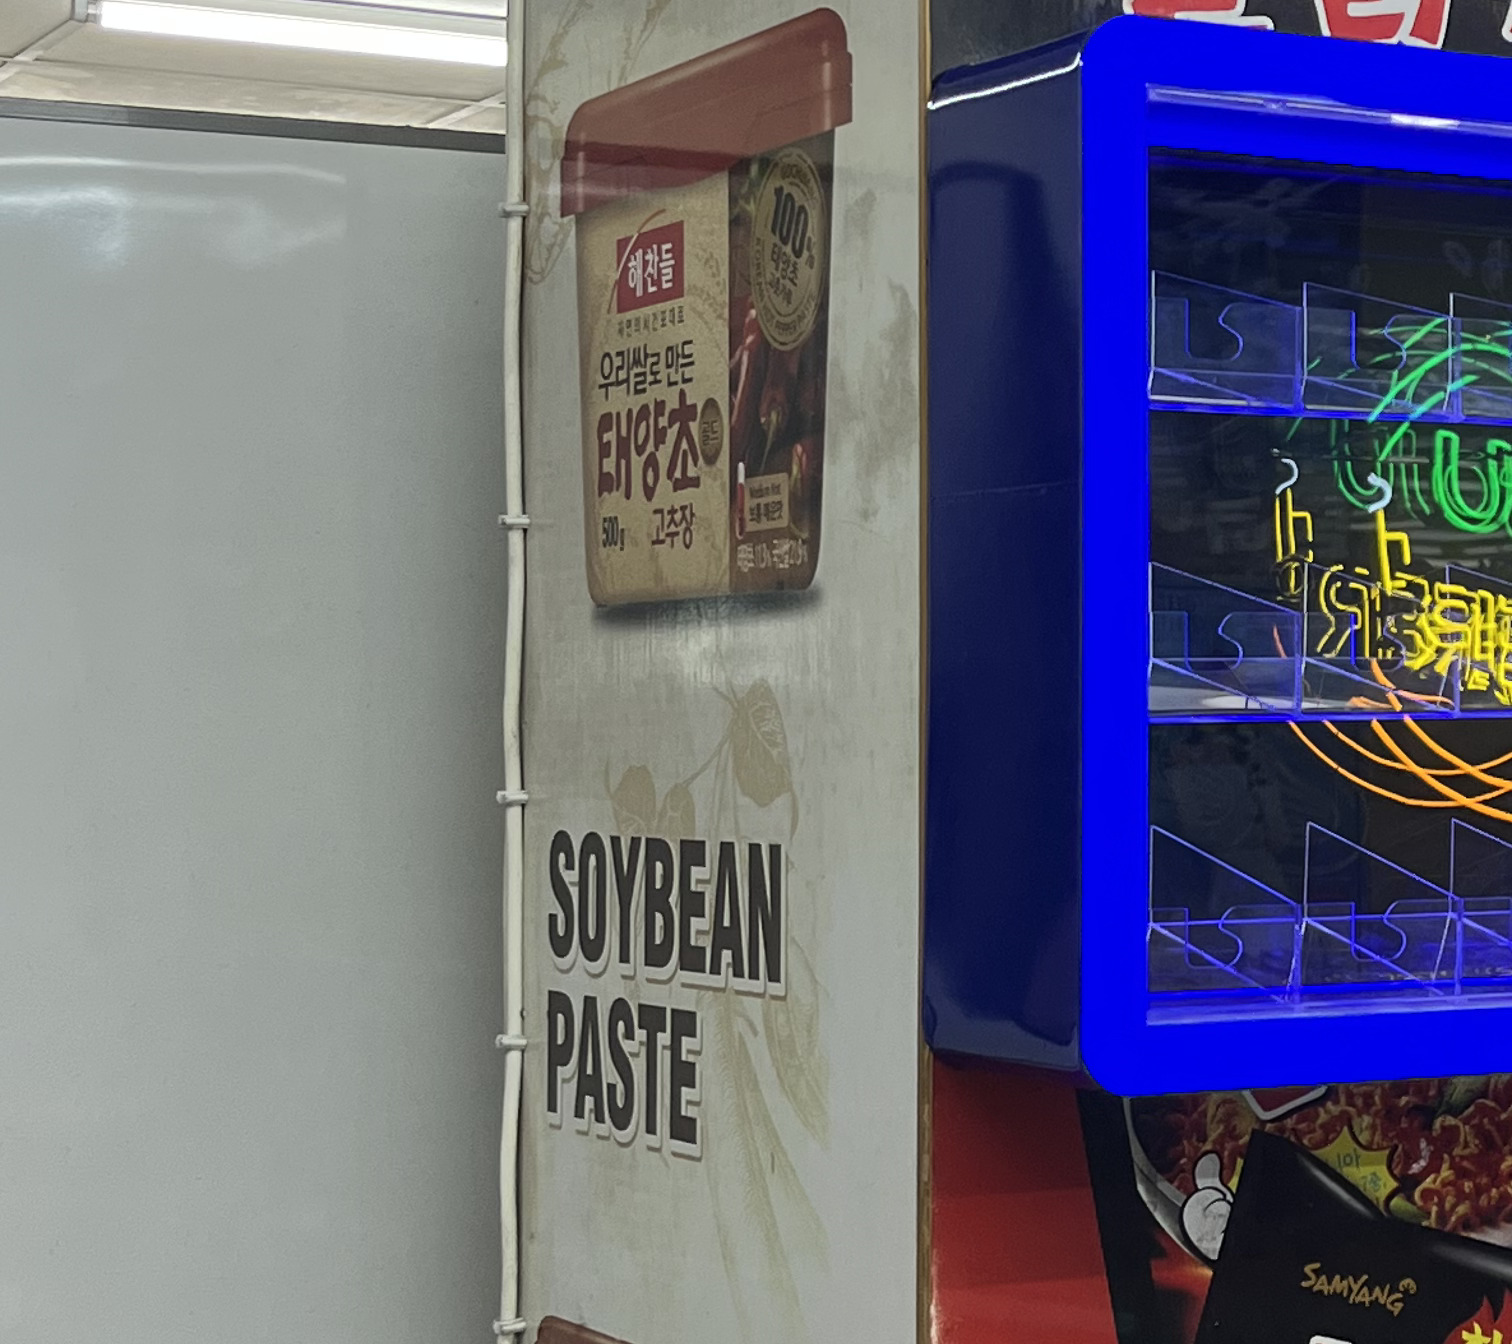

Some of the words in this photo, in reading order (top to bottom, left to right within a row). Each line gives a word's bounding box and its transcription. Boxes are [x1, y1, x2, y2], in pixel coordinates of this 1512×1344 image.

[628, 242, 675, 297] 해찬들
[598, 343, 662, 401] 우리쌀로
[665, 340, 695, 388] 만든
[597, 388, 700, 502] 태양초
[651, 503, 695, 550] 고추장
[548, 829, 782, 984] SOYBEAN
[547, 990, 698, 1145] PASTE
[1301, 1262, 1408, 1316] SAMYANG
